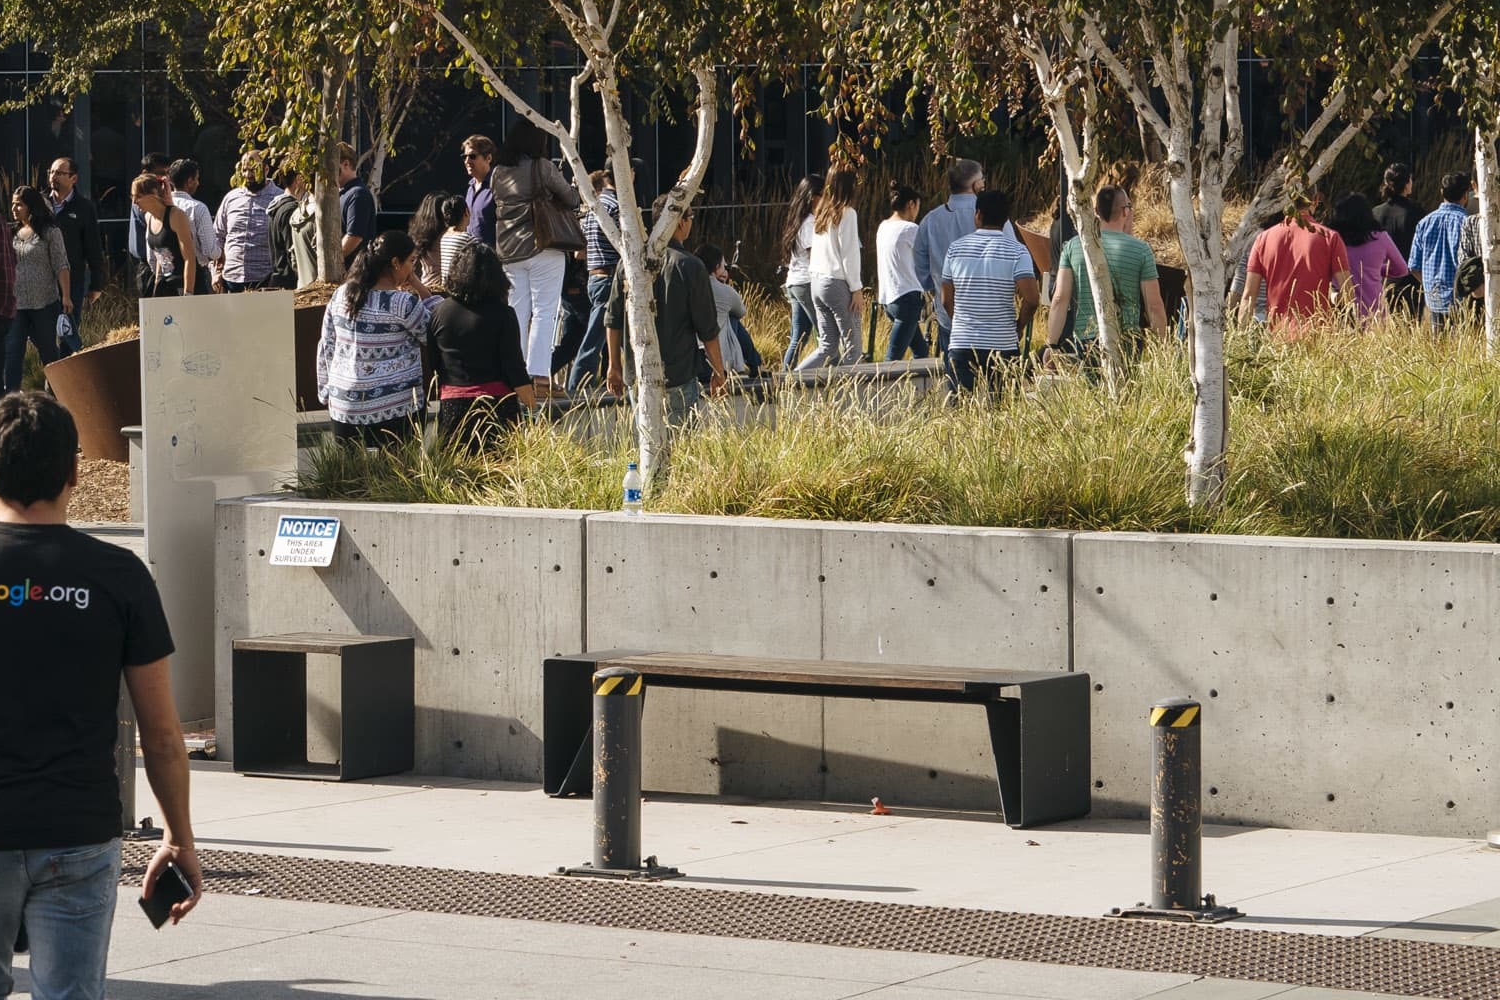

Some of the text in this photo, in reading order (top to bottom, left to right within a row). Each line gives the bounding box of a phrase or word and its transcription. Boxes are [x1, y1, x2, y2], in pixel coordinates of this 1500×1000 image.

[281, 520, 335, 536] NOTICE
[287, 539, 323, 548] THIS AREA
[290, 547, 316, 555] UNDER
[274, 554, 328, 563] SURVEILLANCE
